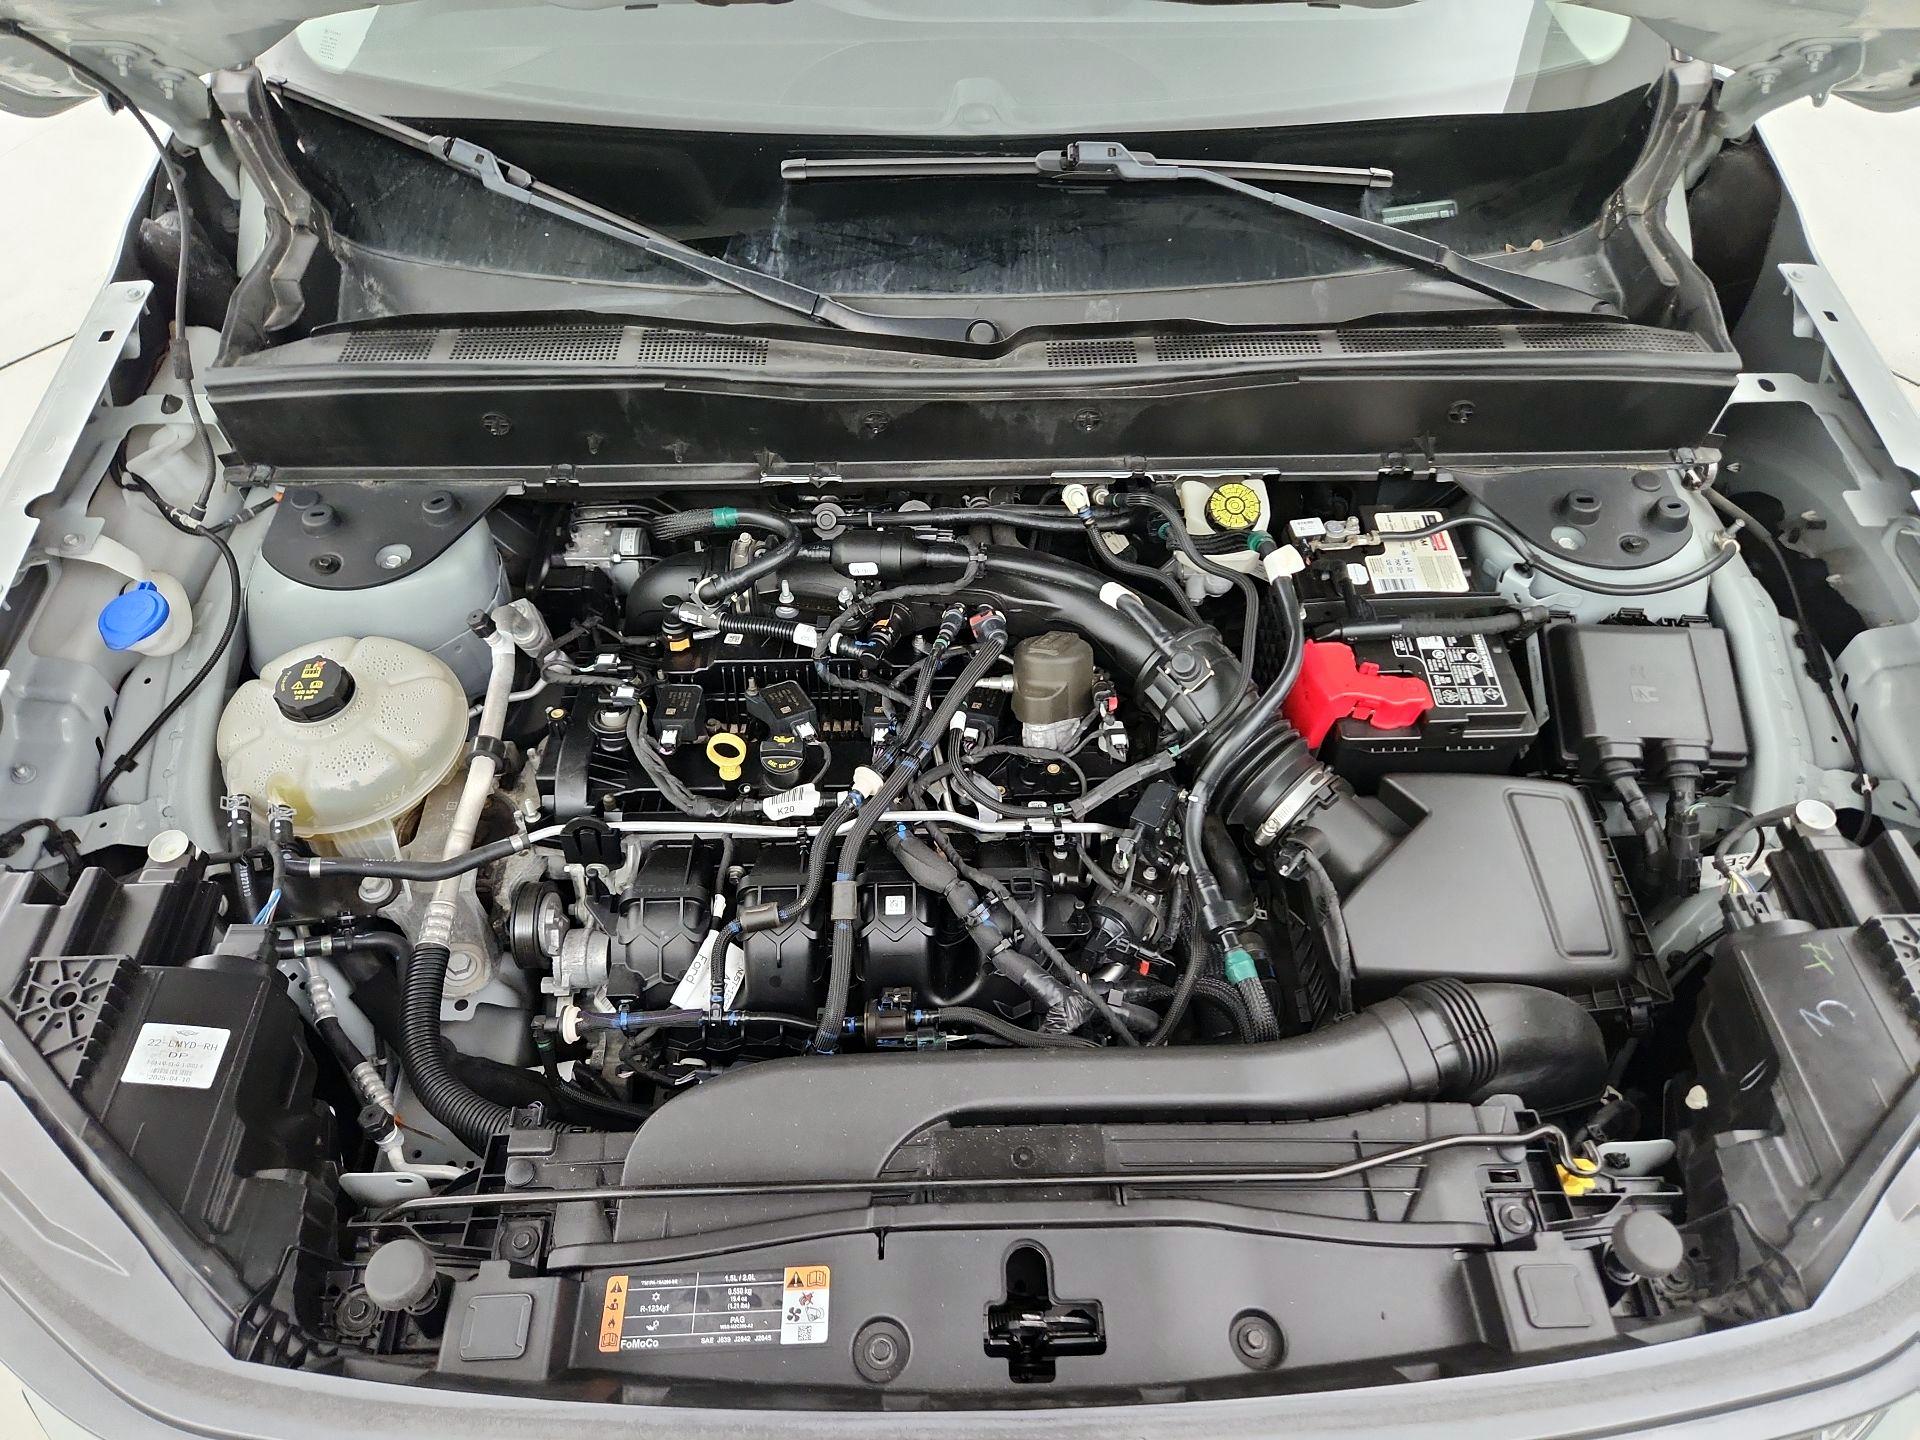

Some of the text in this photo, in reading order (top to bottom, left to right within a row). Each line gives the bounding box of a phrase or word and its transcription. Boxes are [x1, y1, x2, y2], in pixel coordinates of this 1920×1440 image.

[777, 805, 795, 816] K20
[686, 953, 708, 984] Ford
[147, 1039, 218, 1051] 22-LMYD-RH
[168, 1051, 189, 1059] DP
[744, 1287, 753, 1296] kg
[639, 1304, 670, 1314] R-1234yf
[729, 1315, 746, 1324] PAG
[620, 1338, 660, 1349] FoMoCo
